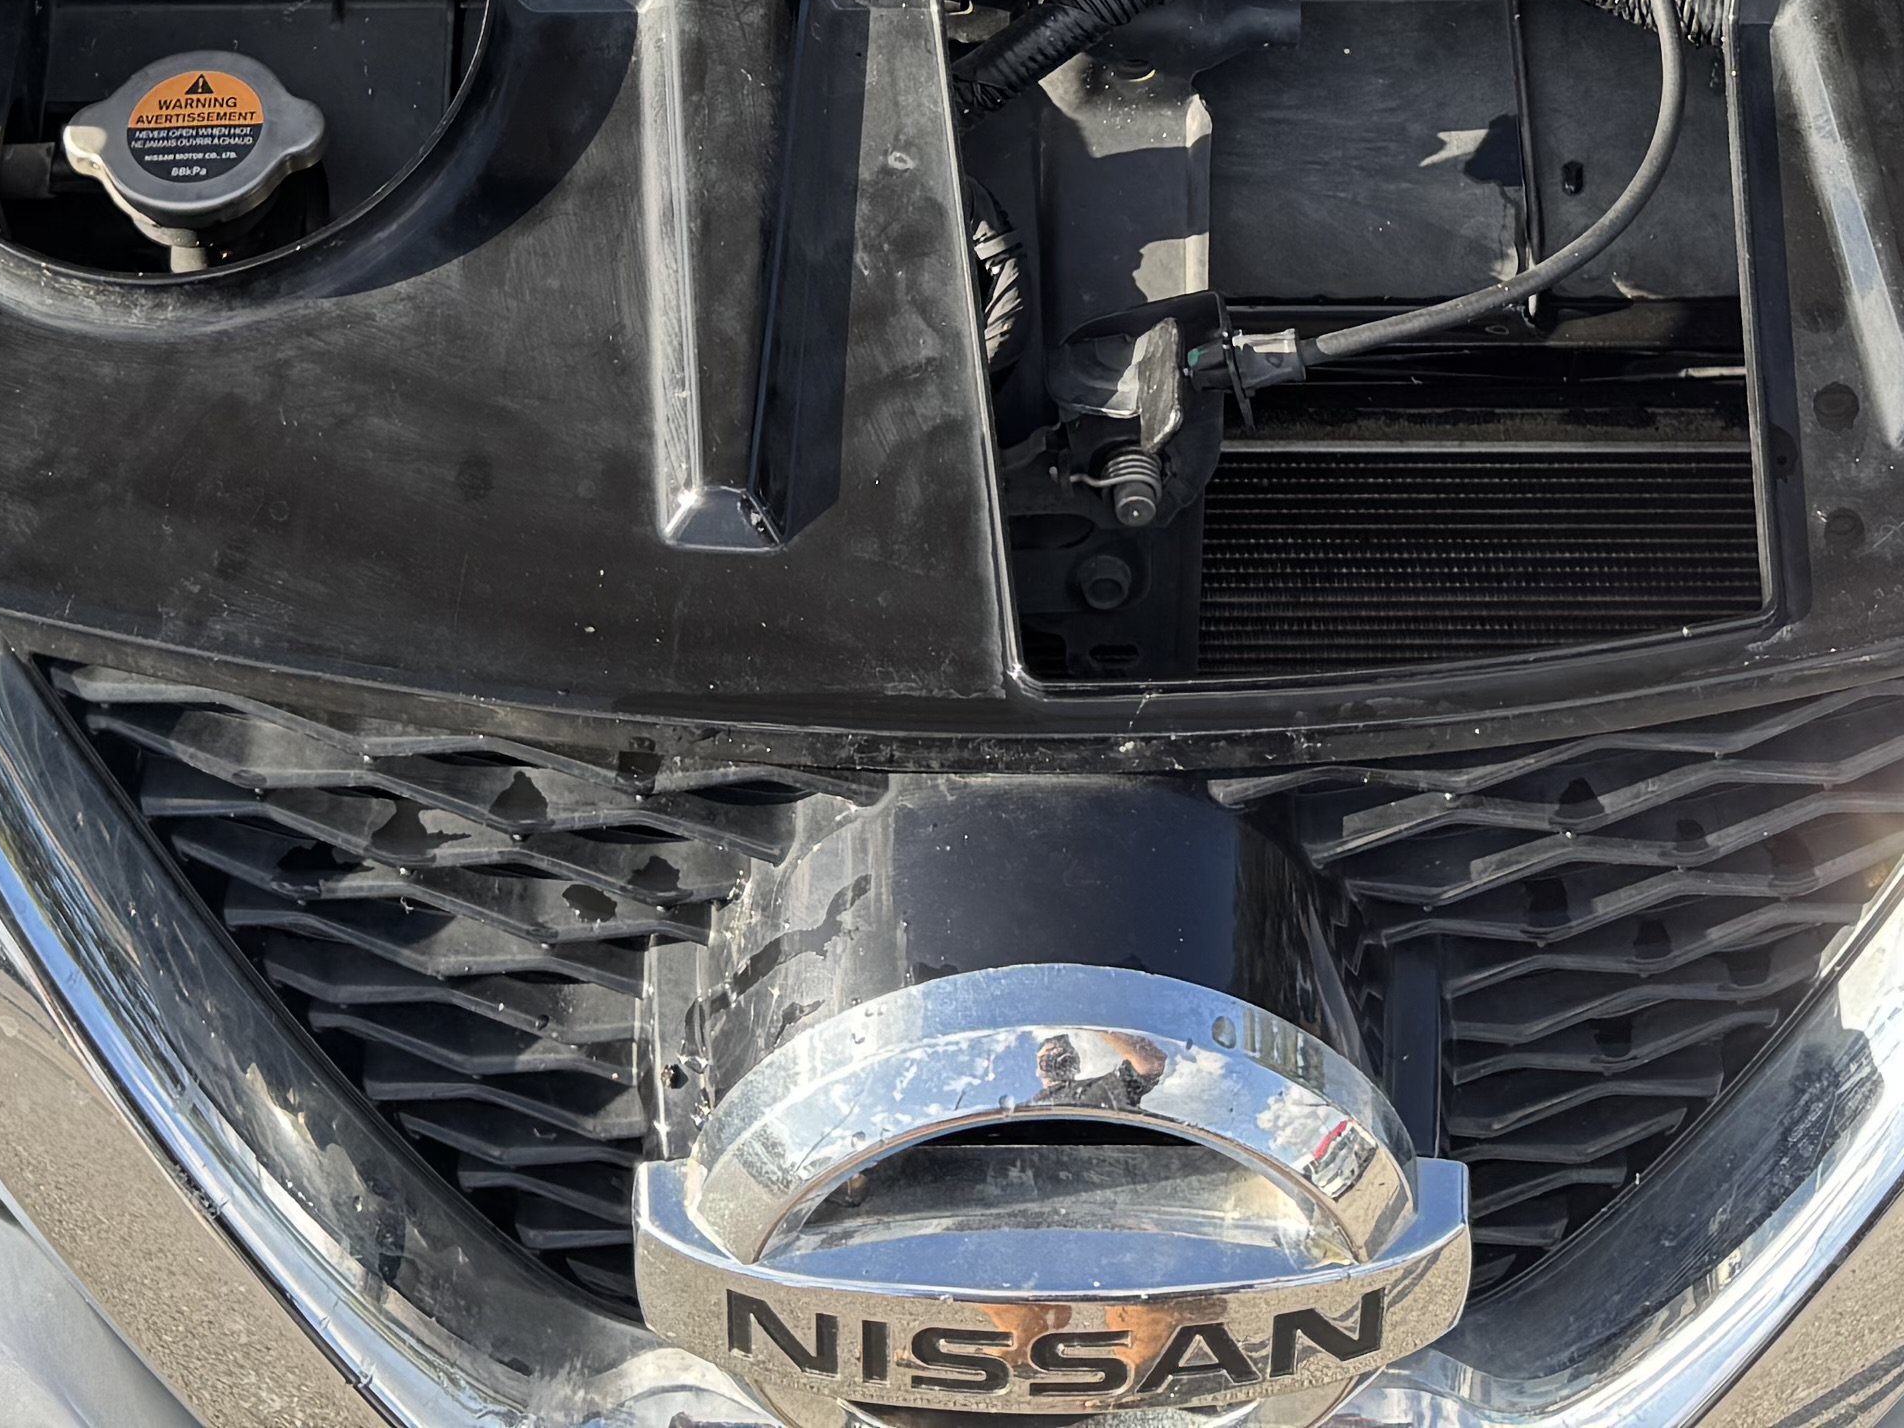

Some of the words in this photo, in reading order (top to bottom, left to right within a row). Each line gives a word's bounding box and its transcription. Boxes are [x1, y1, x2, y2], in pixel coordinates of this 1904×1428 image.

[158, 97, 238, 111] WARNING
[136, 111, 256, 125] AVERTISSEMENT
[135, 130, 167, 139] NEVER
[168, 129, 196, 138] OPEN
[198, 127, 229, 136] WHEN
[131, 141, 143, 149] NE
[144, 139, 176, 148] JAMAIS
[144, 153, 174, 161] NISSAN
[175, 152, 204, 160] MOTOR
[725, 1285, 1386, 1399] NISSAN
